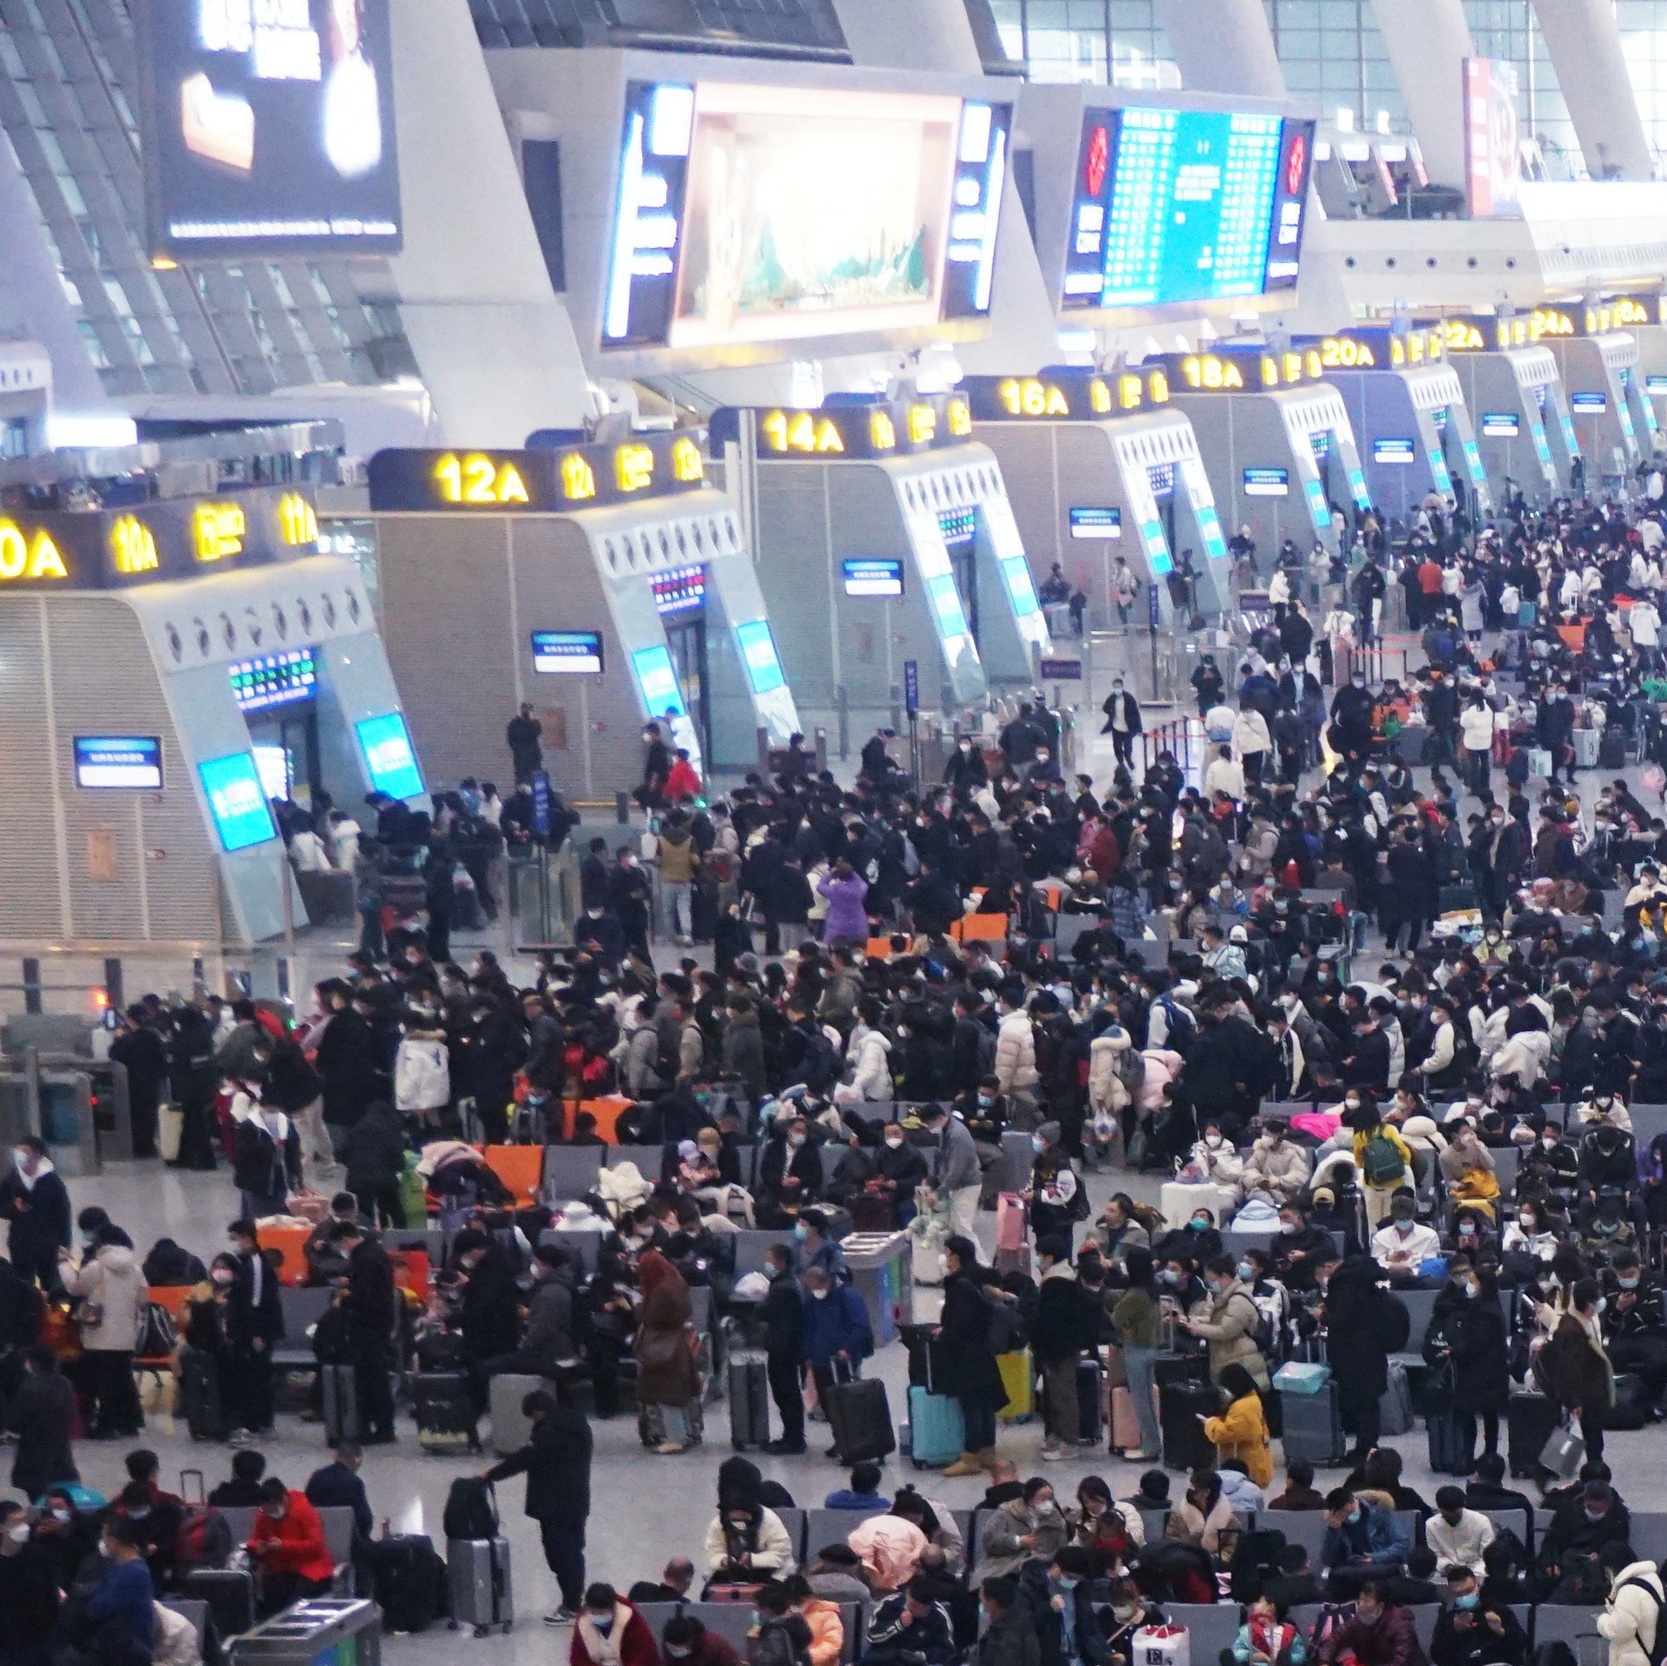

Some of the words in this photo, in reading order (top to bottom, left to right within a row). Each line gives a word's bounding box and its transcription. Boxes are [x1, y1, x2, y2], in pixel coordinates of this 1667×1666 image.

[1321, 338, 1375, 367] 20A
[1183, 356, 1243, 388] 18A
[1000, 377, 1069, 415] 16A
[763, 409, 844, 452] 14A
[433, 452, 529, 502] 12A
